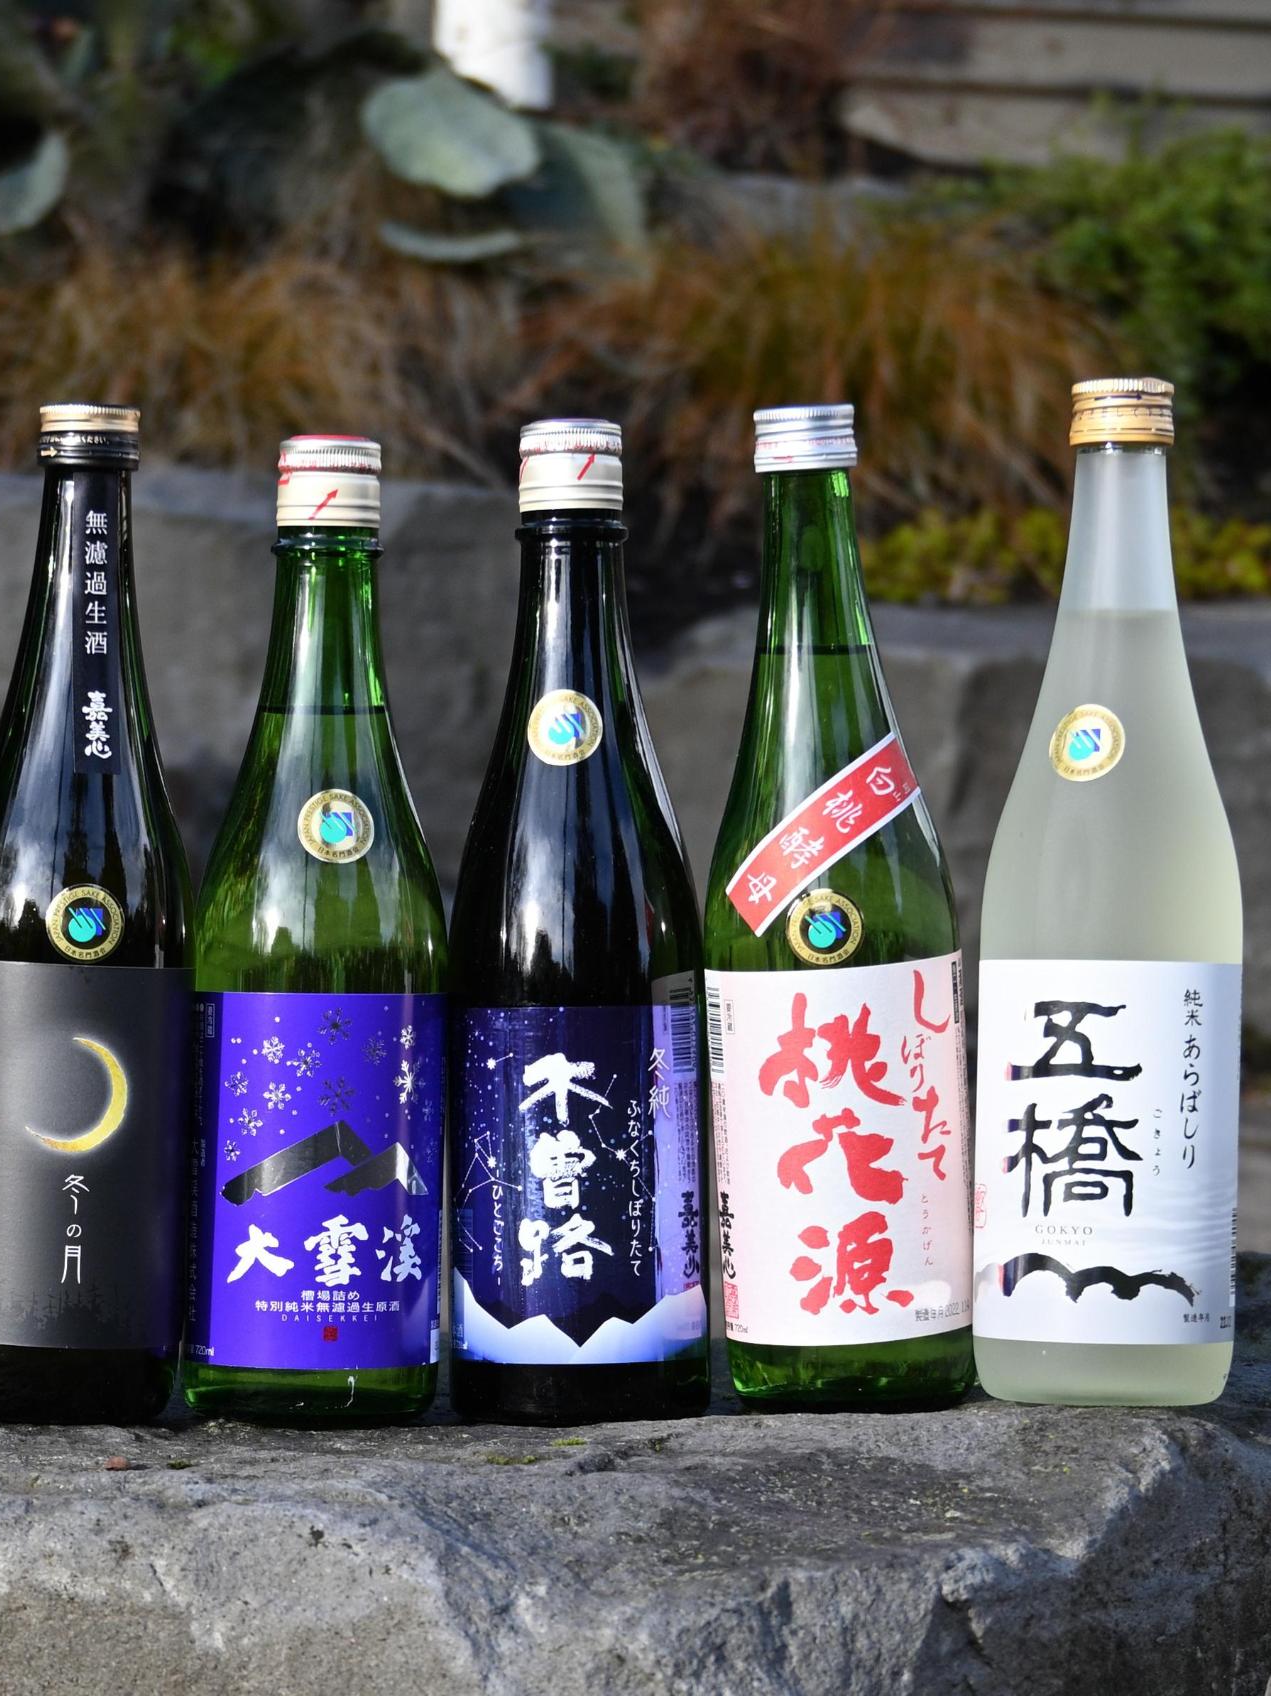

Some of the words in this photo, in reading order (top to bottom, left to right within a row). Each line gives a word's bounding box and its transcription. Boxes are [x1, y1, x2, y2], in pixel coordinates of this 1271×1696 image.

[85, 509, 108, 656] 無濾過生酒
[82, 690, 113, 760] 嘉美心
[746, 765, 895, 905] 白桃酵母
[900, 968, 951, 1182] しぼりたて
[1002, 1000, 1144, 1218] 五橋
[627, 1099, 643, 1277] ふなくちしぼりたて
[758, 992, 914, 1315] 桃花源
[61, 1174, 90, 1284] 冬の月
[1034, 1224, 1094, 1236] GOKYO
[255, 1301, 400, 1313] 特別純米無濾過生原酒
[282, 1314, 378, 1322] DAISEKKEI
[300, 1290, 360, 1301] 槽場詰め
